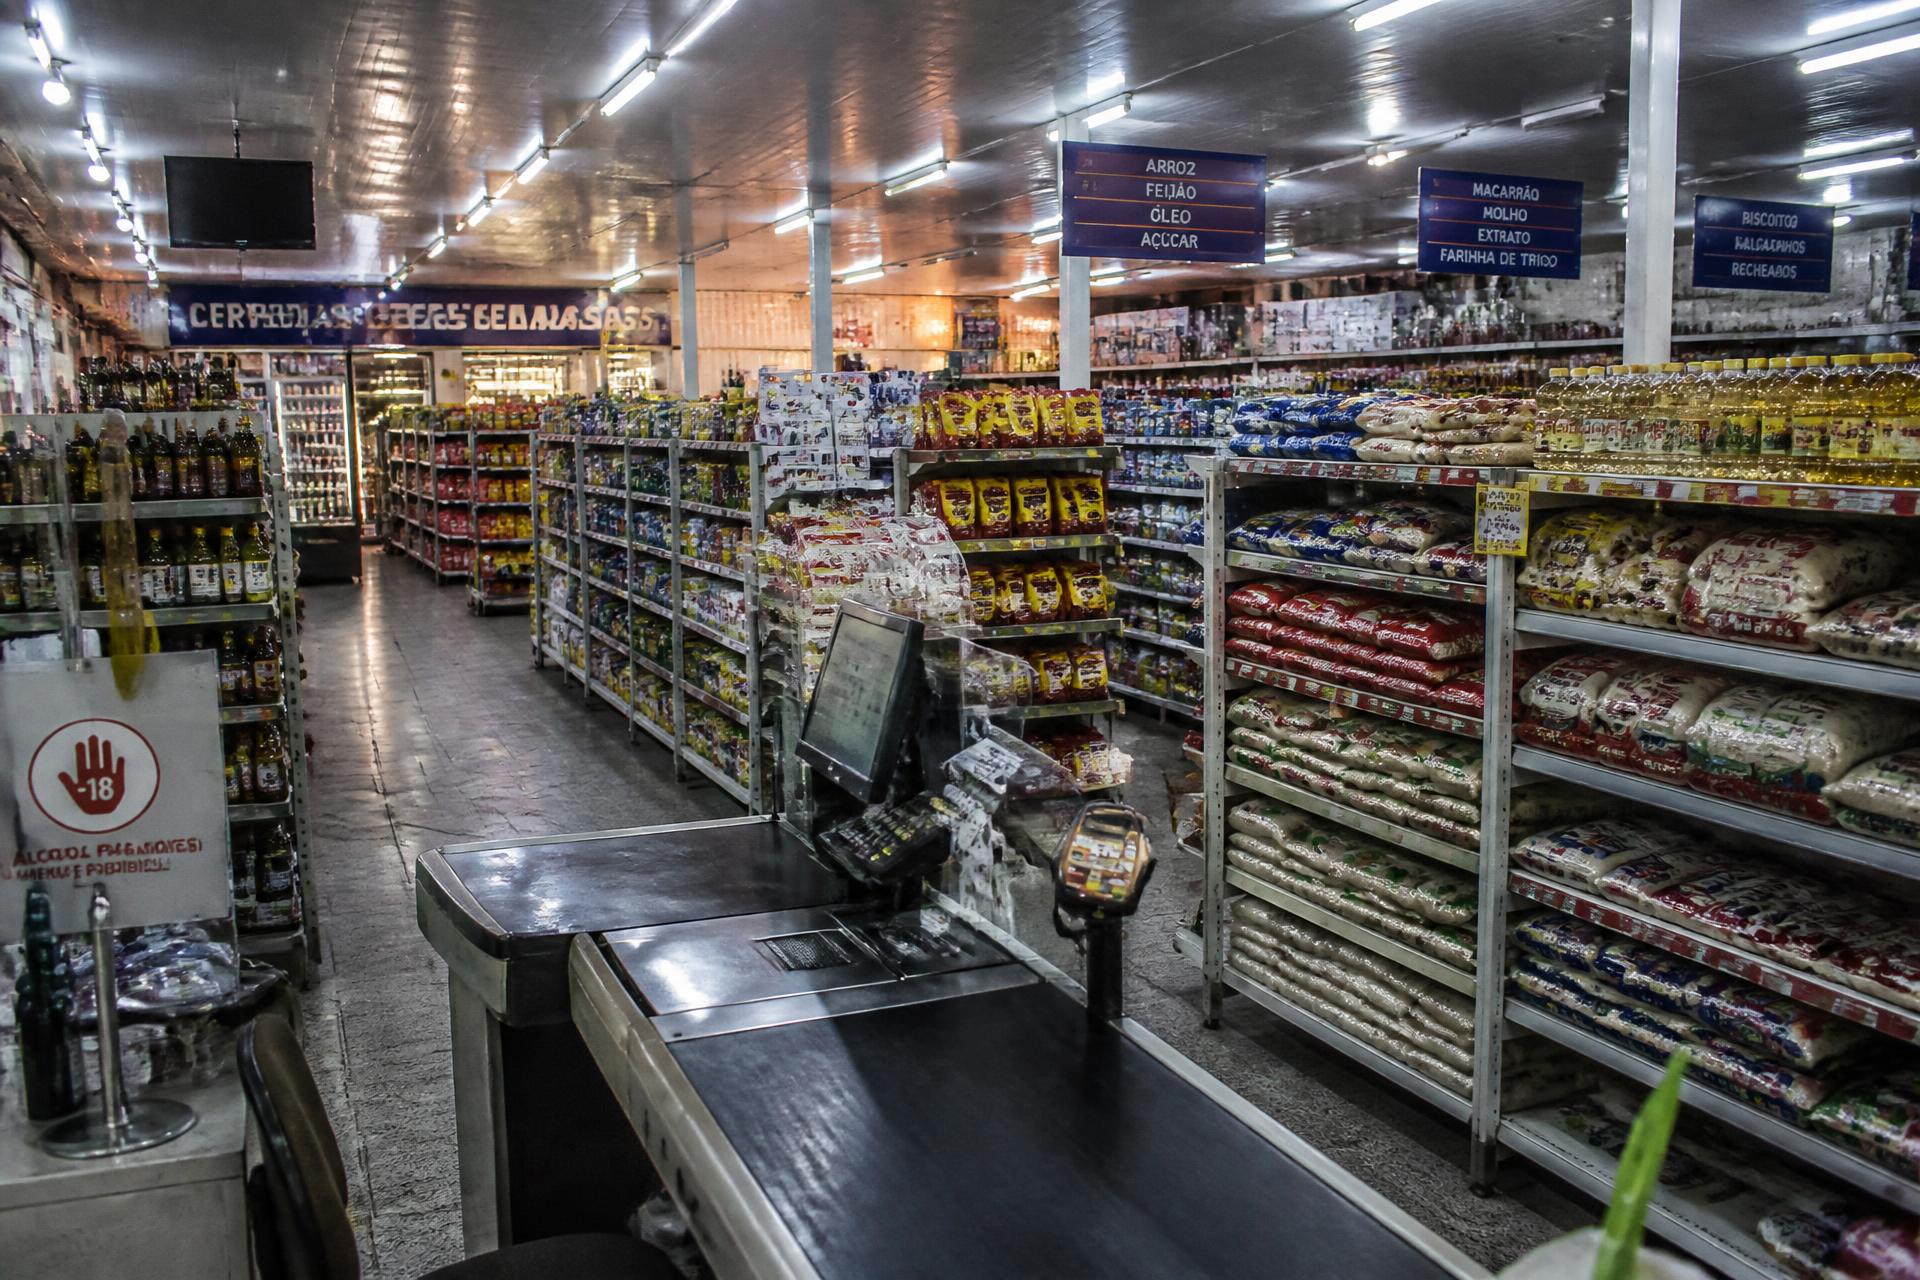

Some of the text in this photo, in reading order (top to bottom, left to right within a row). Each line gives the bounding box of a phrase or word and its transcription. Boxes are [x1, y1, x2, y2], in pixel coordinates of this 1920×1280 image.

[1483, 206, 1528, 222] MOLHO
[1478, 228, 1531, 245] EXTRATO
[1500, 252, 1516, 266] DE
